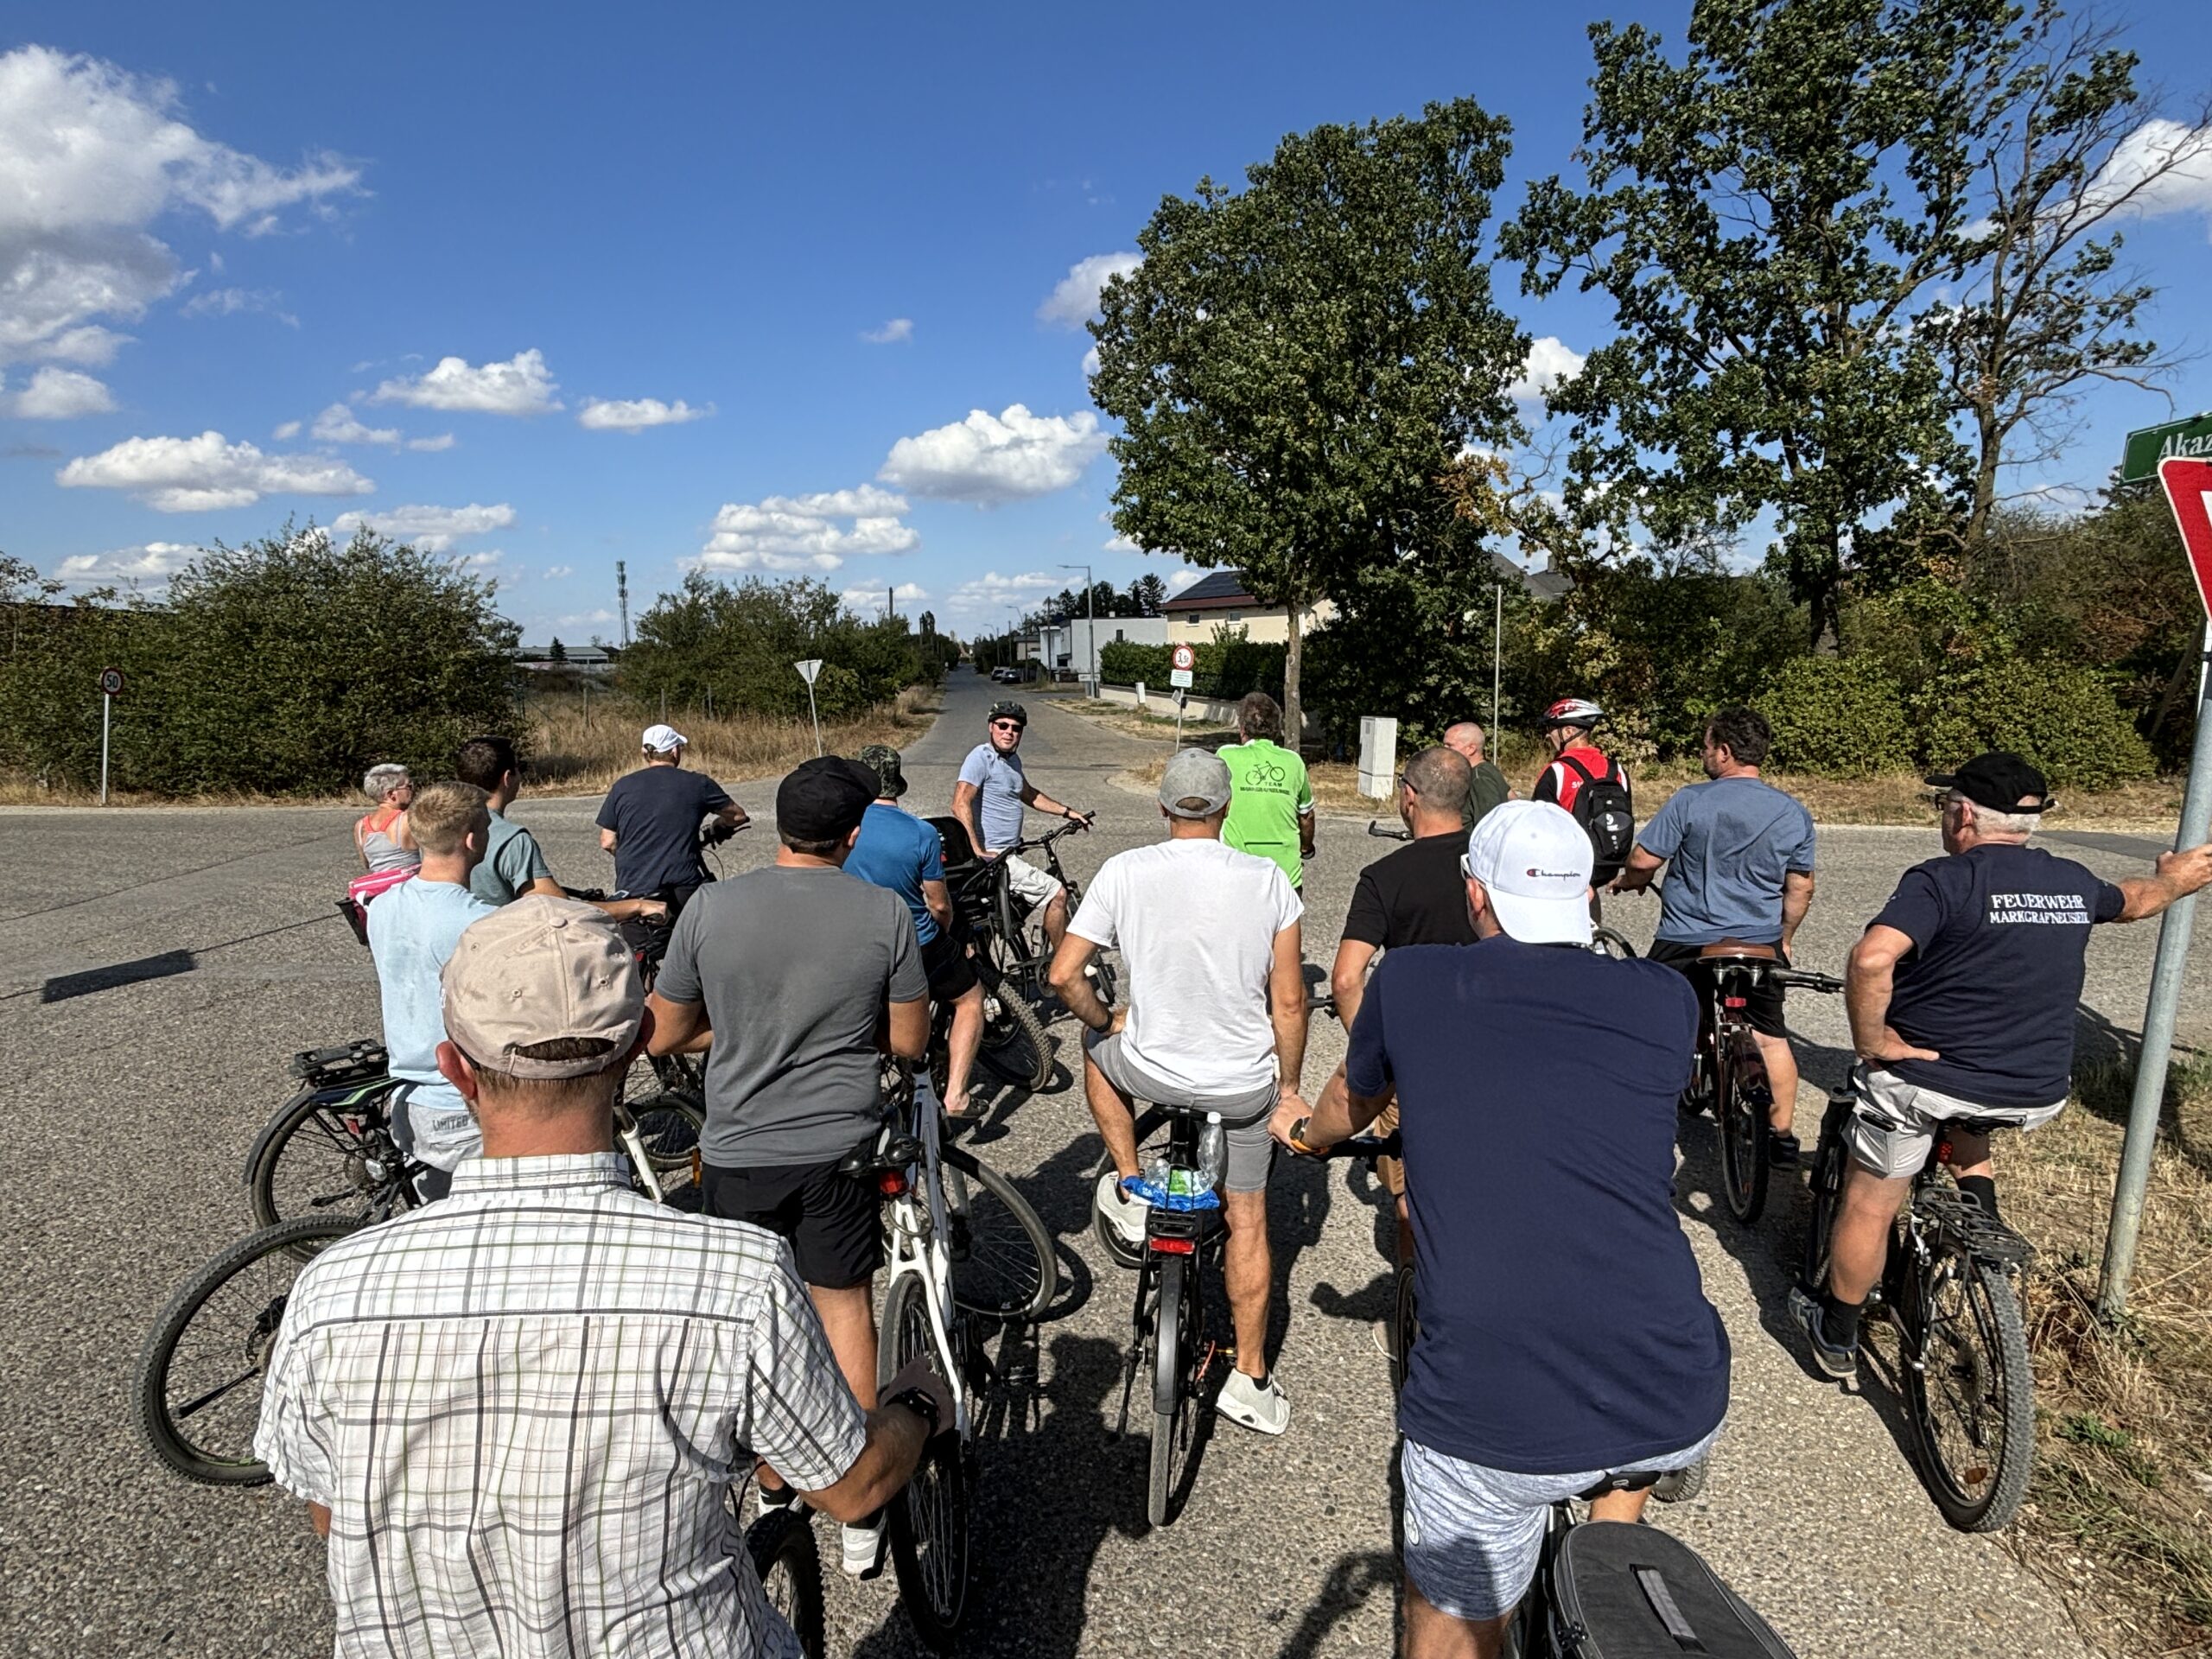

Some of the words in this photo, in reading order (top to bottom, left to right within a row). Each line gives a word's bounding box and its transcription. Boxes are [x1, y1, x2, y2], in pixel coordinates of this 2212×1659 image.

[106, 674, 118, 689] 50
[1526, 868, 1581, 881] Champion
[1990, 893, 2087, 909] FEUERWEHR
